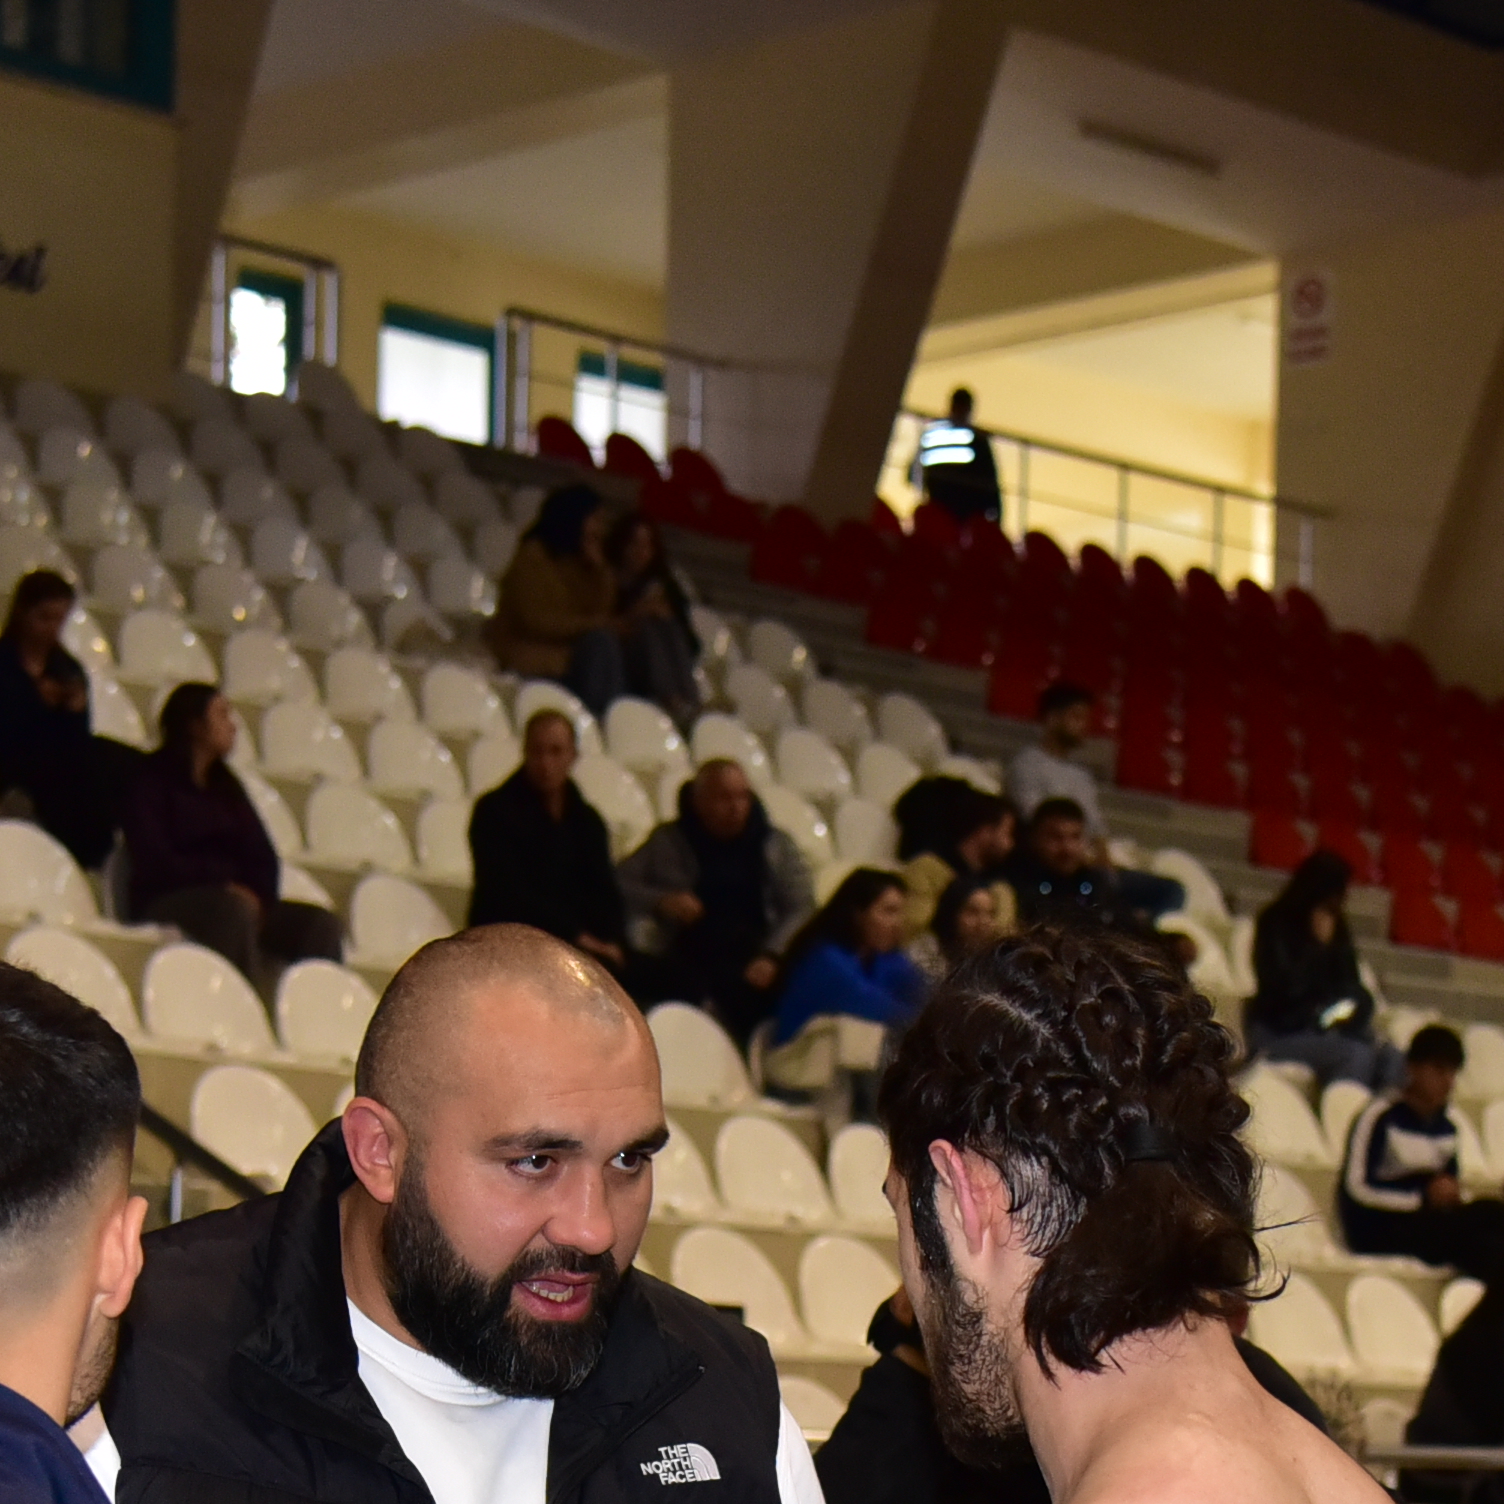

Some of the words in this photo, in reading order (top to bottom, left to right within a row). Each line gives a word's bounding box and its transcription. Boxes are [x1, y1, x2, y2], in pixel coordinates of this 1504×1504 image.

[658, 1444, 689, 1459] THE
[640, 1456, 692, 1475] NORTH
[659, 1469, 696, 1485] FACE
